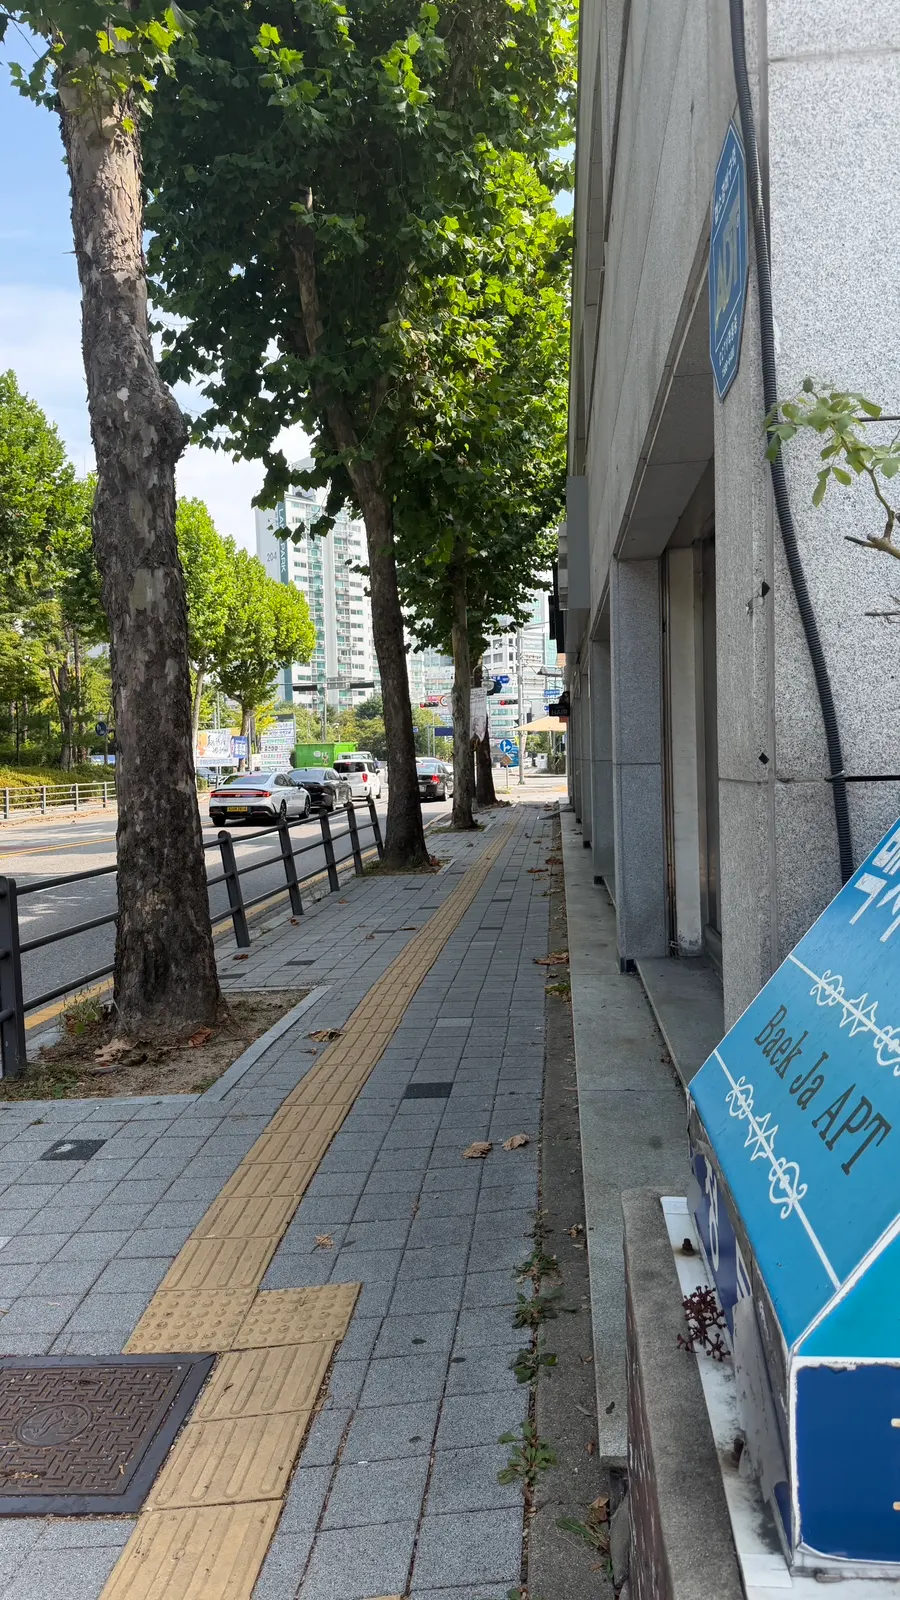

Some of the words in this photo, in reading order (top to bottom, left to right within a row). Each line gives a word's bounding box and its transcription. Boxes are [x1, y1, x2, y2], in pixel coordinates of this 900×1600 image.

[715, 192, 740, 329] ADT
[754, 1004, 804, 1080] Baek
[789, 1051, 829, 1112] Ja
[811, 1083, 892, 1176] APT
